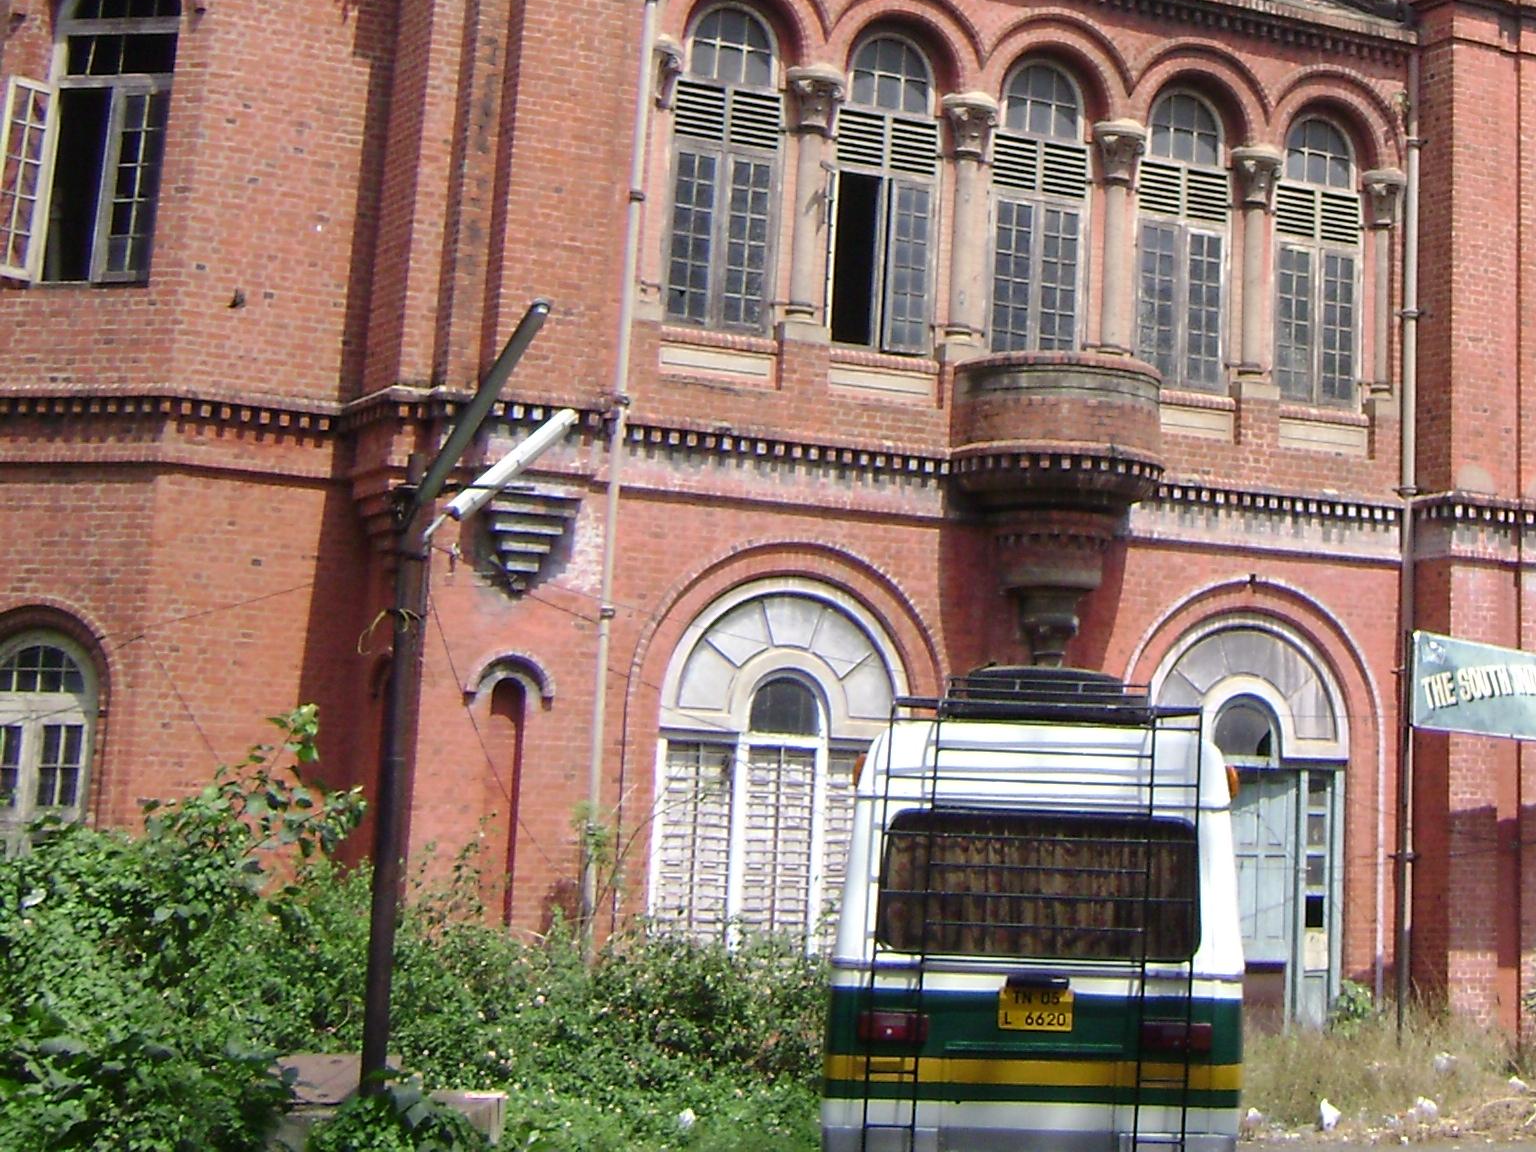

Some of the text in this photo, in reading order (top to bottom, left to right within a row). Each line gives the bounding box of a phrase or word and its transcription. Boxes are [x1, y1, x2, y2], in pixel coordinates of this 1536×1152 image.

[1421, 671, 1458, 711] THE
[1457, 664, 1514, 702] SOUTH
[1014, 991, 1033, 1004] TN
[1004, 1011, 1066, 1026] L 6620
